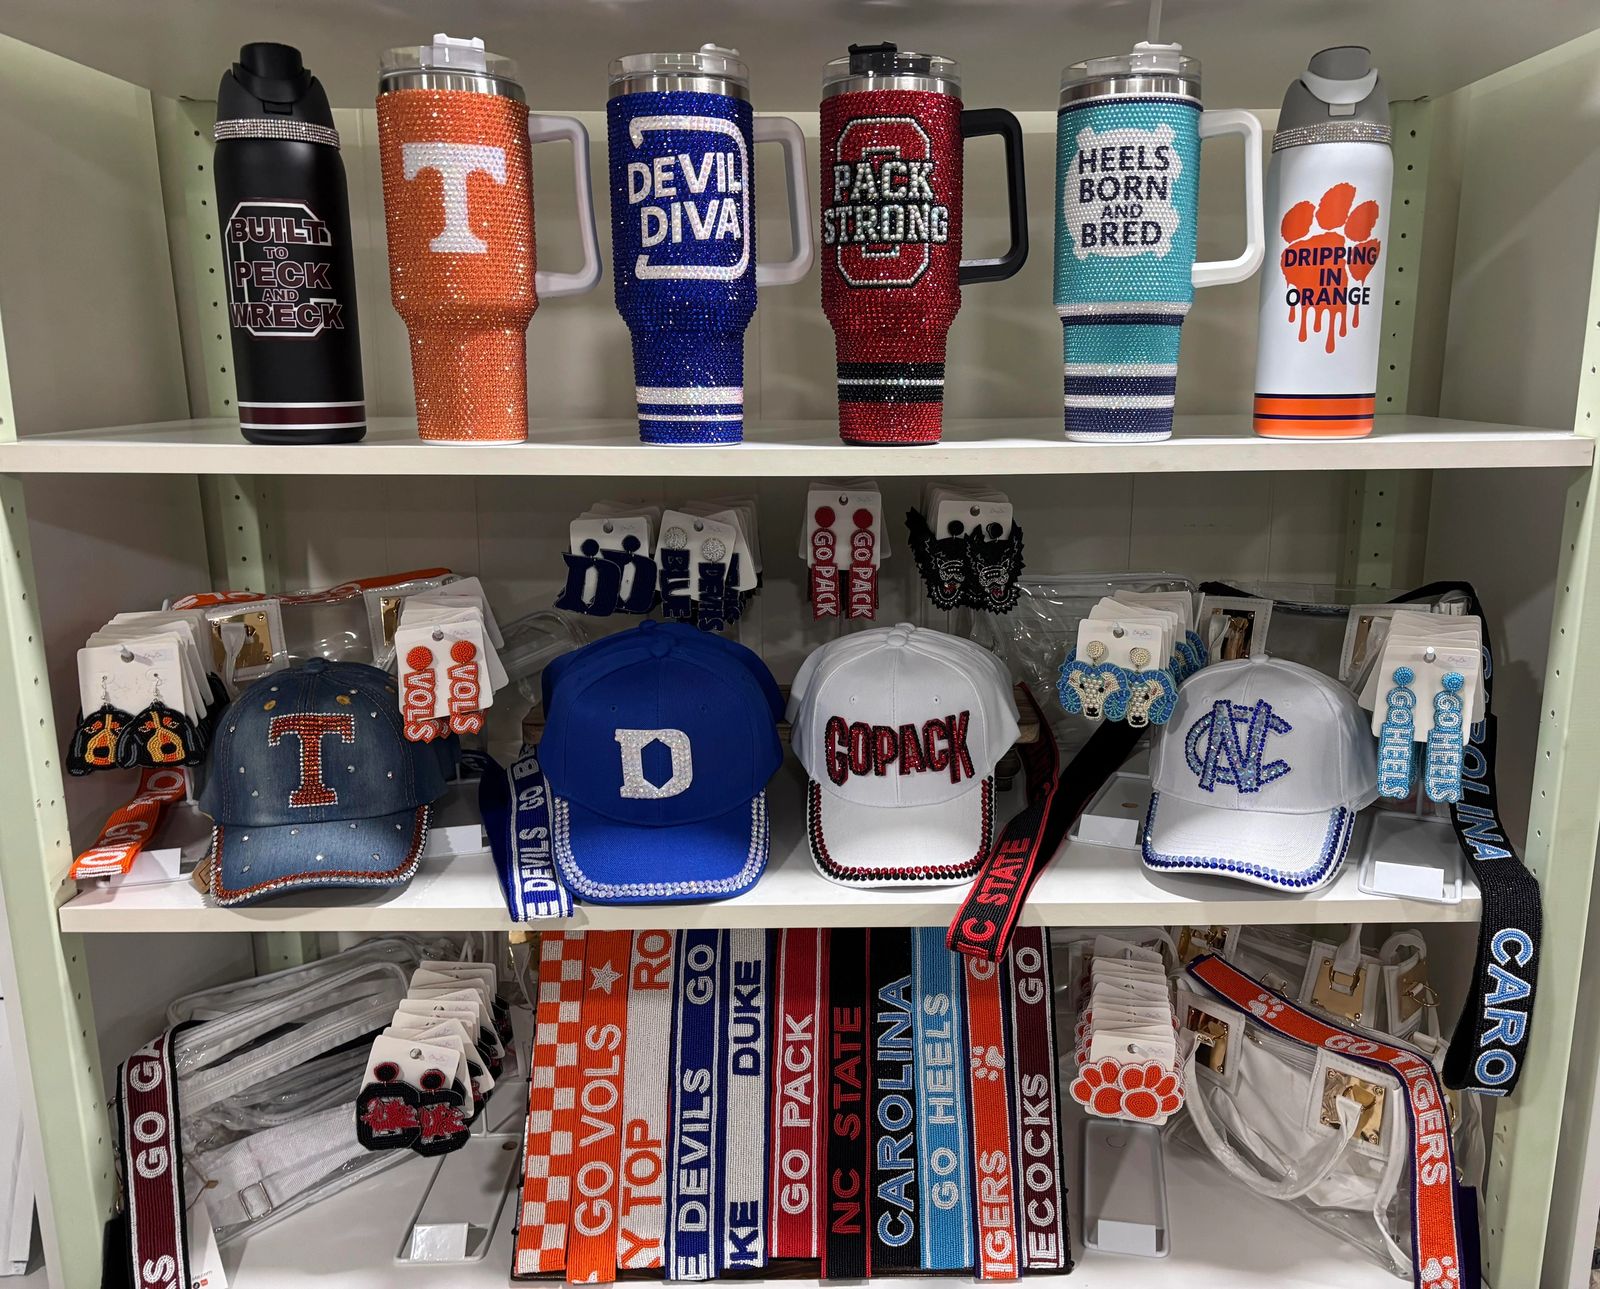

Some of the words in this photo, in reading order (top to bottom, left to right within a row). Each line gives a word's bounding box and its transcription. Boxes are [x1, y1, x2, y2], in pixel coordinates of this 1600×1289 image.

[627, 152, 743, 205] DEVIL
[833, 160, 935, 203] PACK
[1078, 145, 1170, 175] HEELS
[1079, 174, 1168, 202] BORN
[402, 142, 507, 254] T
[640, 198, 742, 248] DIVA
[823, 204, 949, 244] STRONG
[1100, 203, 1144, 220] AND
[229, 216, 331, 245] BUILT
[264, 246, 289, 260] TO
[1081, 221, 1163, 249] BRED
[1284, 246, 1378, 268] DRIPPING
[234, 261, 332, 290] PECK
[262, 288, 300, 302] AND
[1286, 286, 1371, 306] ORANGE
[1319, 268, 1342, 286] IN
[230, 303, 345, 329] WRECK
[814, 531, 834, 560] GO
[853, 532, 873, 561] GO
[815, 565, 837, 616] PACK
[851, 566, 873, 617] PACK
[407, 672, 433, 739] VOLS
[452, 664, 479, 731] VOLS
[1388, 689, 1414, 724] GO
[1435, 691, 1461, 727] GO
[267, 712, 356, 809] T
[614, 728, 693, 799] D
[1380, 726, 1413, 799] HEELS
[1428, 731, 1460, 802] HEELS
[519, 785, 545, 811] GO
[519, 826, 558, 892] DEVILS
[977, 838, 1031, 906] STATE
[686, 944, 715, 1006] GO
[1015, 946, 1044, 1005] GO
[732, 960, 762, 1076] DUKE
[578, 1024, 622, 1147] VOLS
[781, 1013, 813, 1128] PACK
[834, 1006, 861, 1141] STATE
[923, 992, 953, 1125] HEELS
[876, 974, 915, 1247] CAROLINA
[1324, 1034, 1378, 1055] GO
[1389, 1051, 1447, 1187] TIGERS
[133, 1110, 169, 1179] GO
[620, 1117, 663, 1216] TOP
[678, 1068, 712, 1233] DEVILS
[1022, 1073, 1058, 1269] ECOCKS
[574, 1160, 615, 1237] GO
[780, 1149, 811, 1215] GO
[831, 1168, 861, 1235] NC
[930, 1146, 960, 1210] GO
[730, 1201, 759, 1269] KE
[978, 1149, 1013, 1276] IGERS
